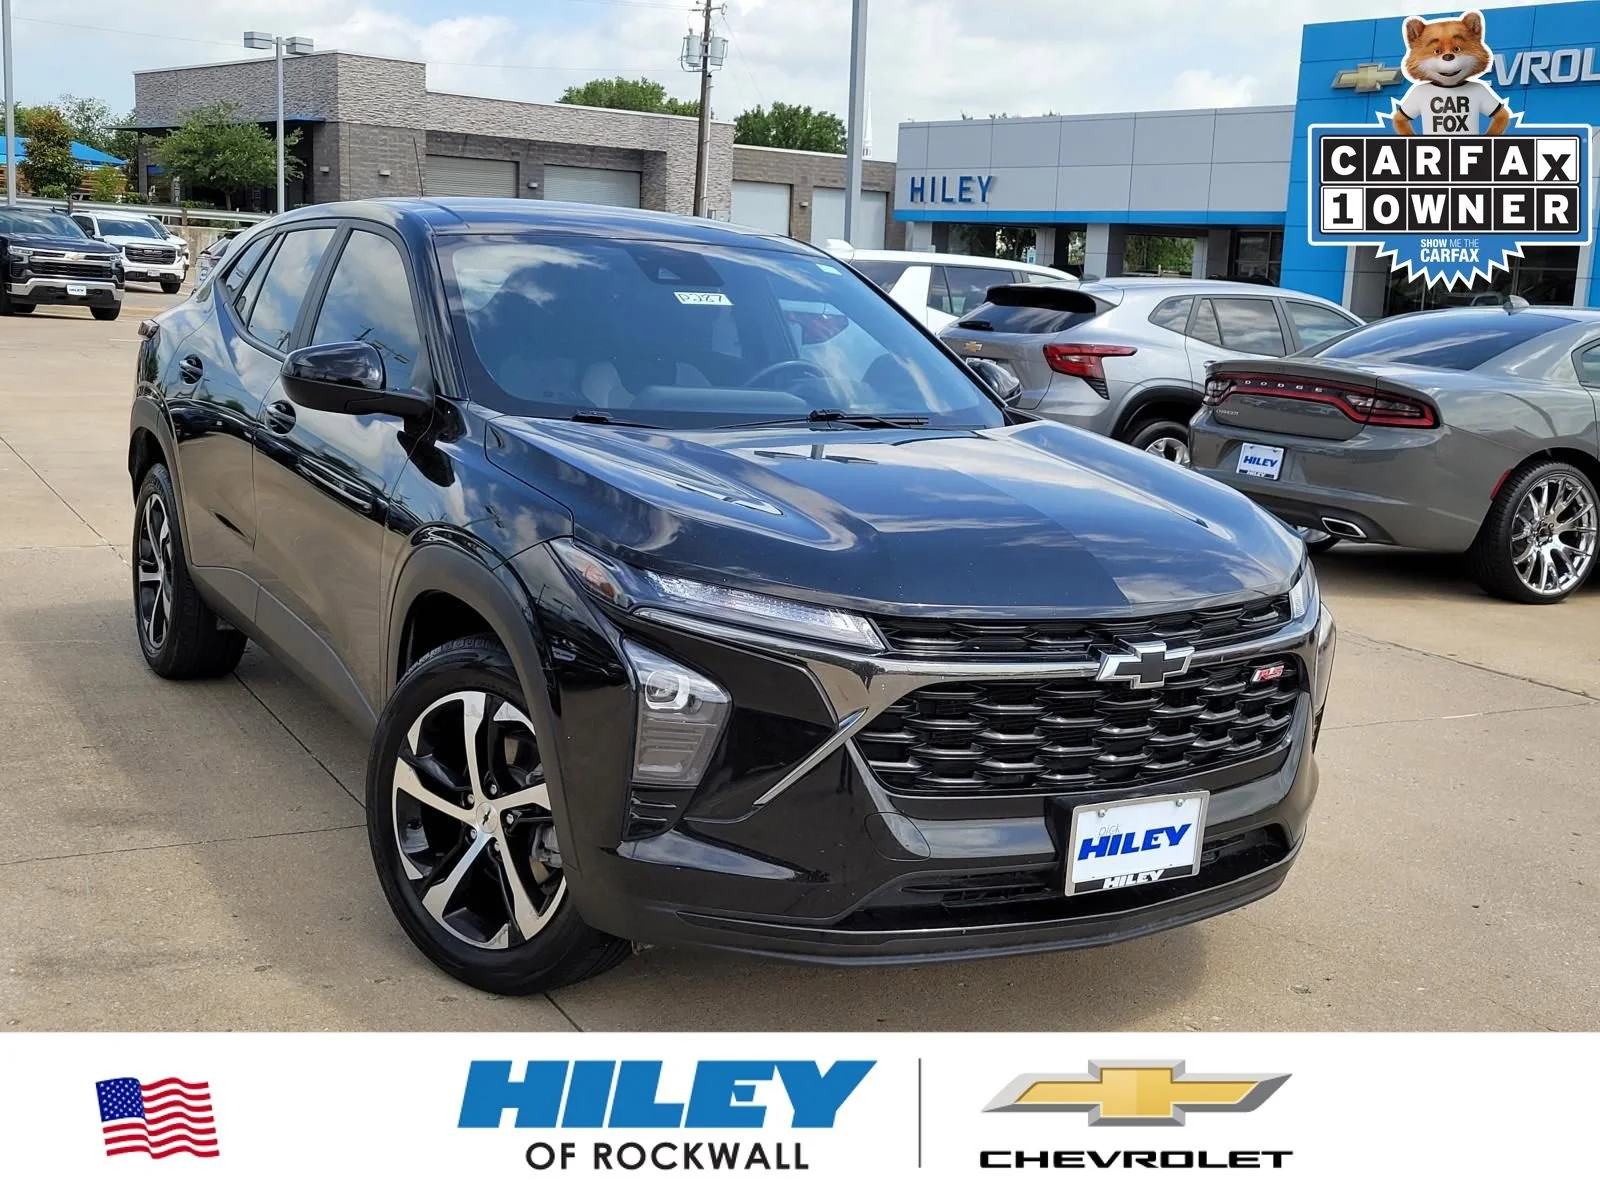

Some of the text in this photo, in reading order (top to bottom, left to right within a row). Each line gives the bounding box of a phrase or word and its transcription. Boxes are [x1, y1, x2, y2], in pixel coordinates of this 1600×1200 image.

[910, 176, 993, 203] HILEY
[1245, 380, 1322, 392] DODGE
[1243, 455, 1278, 468] HILEY
[1077, 823, 1192, 861] HILEY
[1102, 869, 1165, 889] HILEY
